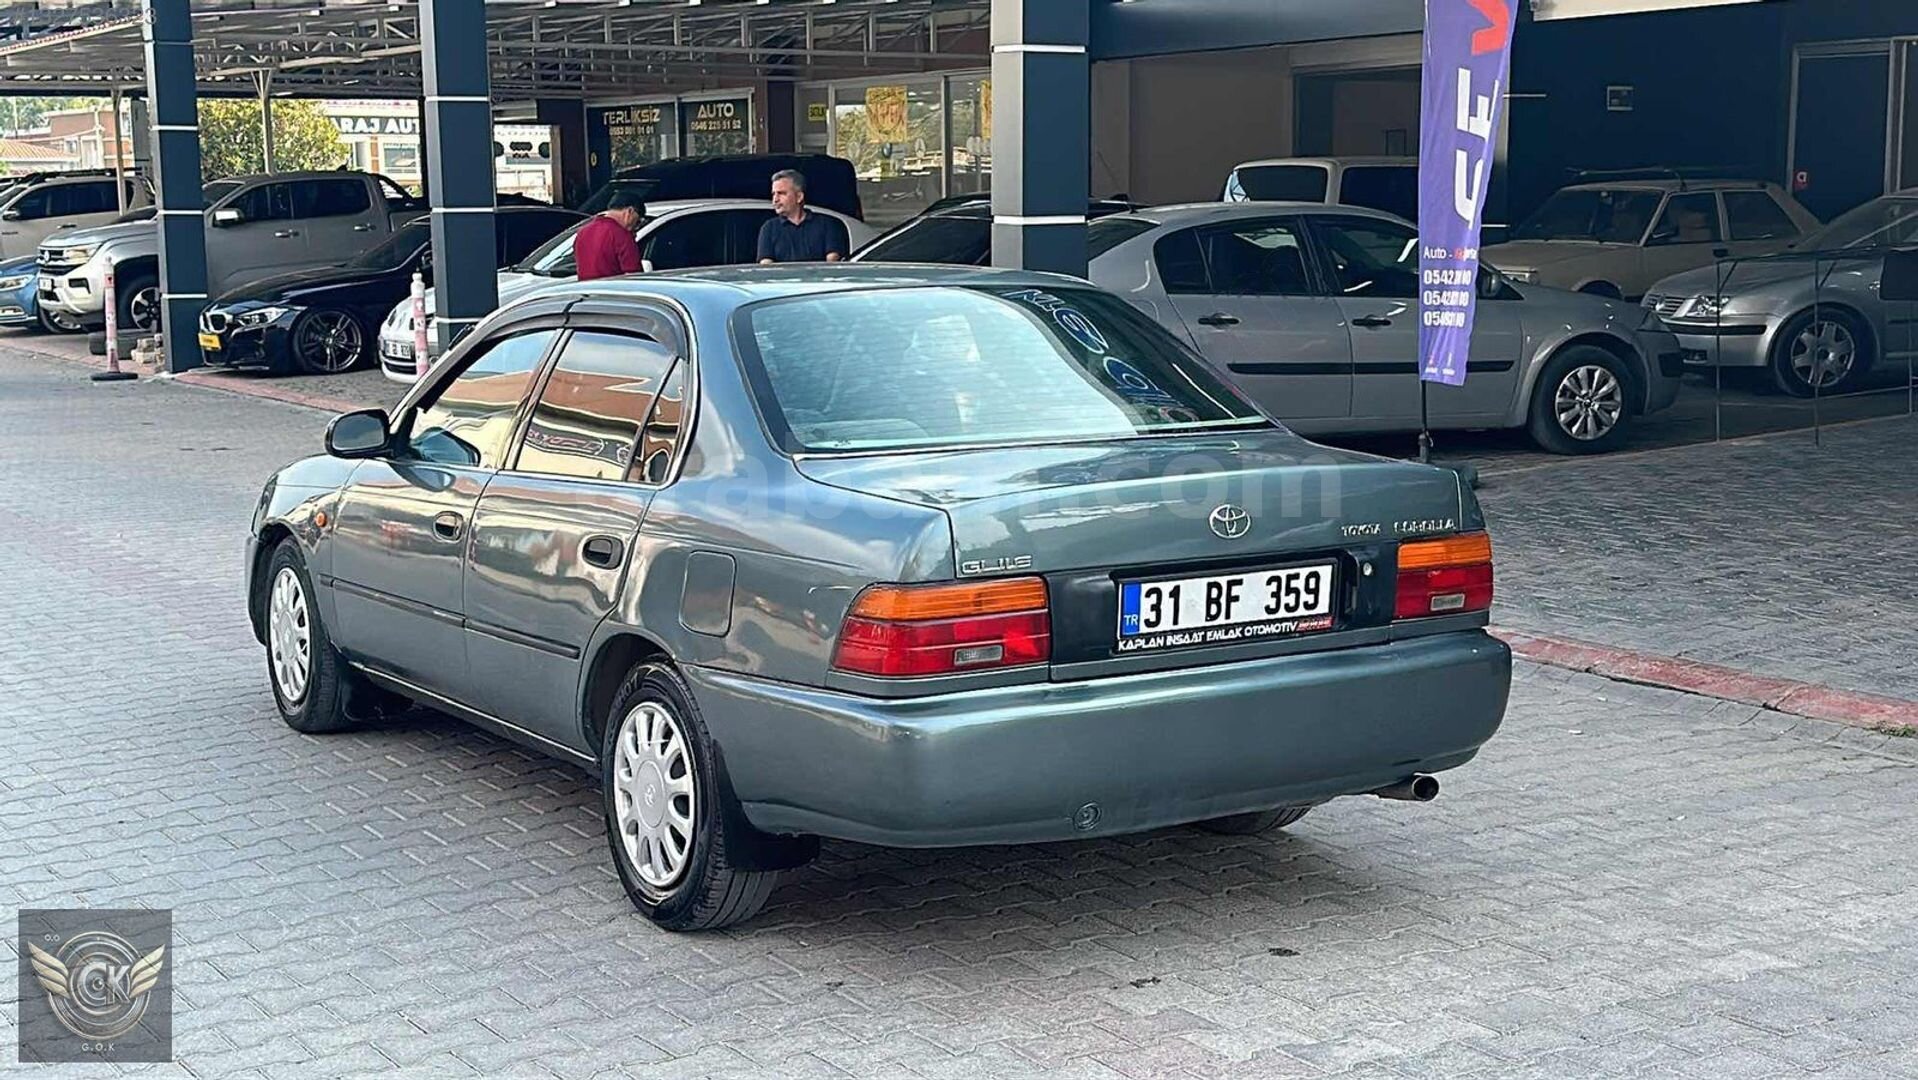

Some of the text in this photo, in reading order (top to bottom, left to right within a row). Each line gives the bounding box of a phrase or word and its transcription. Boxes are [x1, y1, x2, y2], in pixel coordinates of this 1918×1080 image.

[697, 103, 735, 119] AUTO
[1423, 246, 1446, 259] Auto
[1341, 523, 1381, 536] TOYOTA
[1143, 570, 1321, 628] 31 BF 359
[1124, 613, 1138, 626] TR
[1118, 637, 1165, 652] KAPLAN
[1206, 625, 1243, 642] EMLAK
